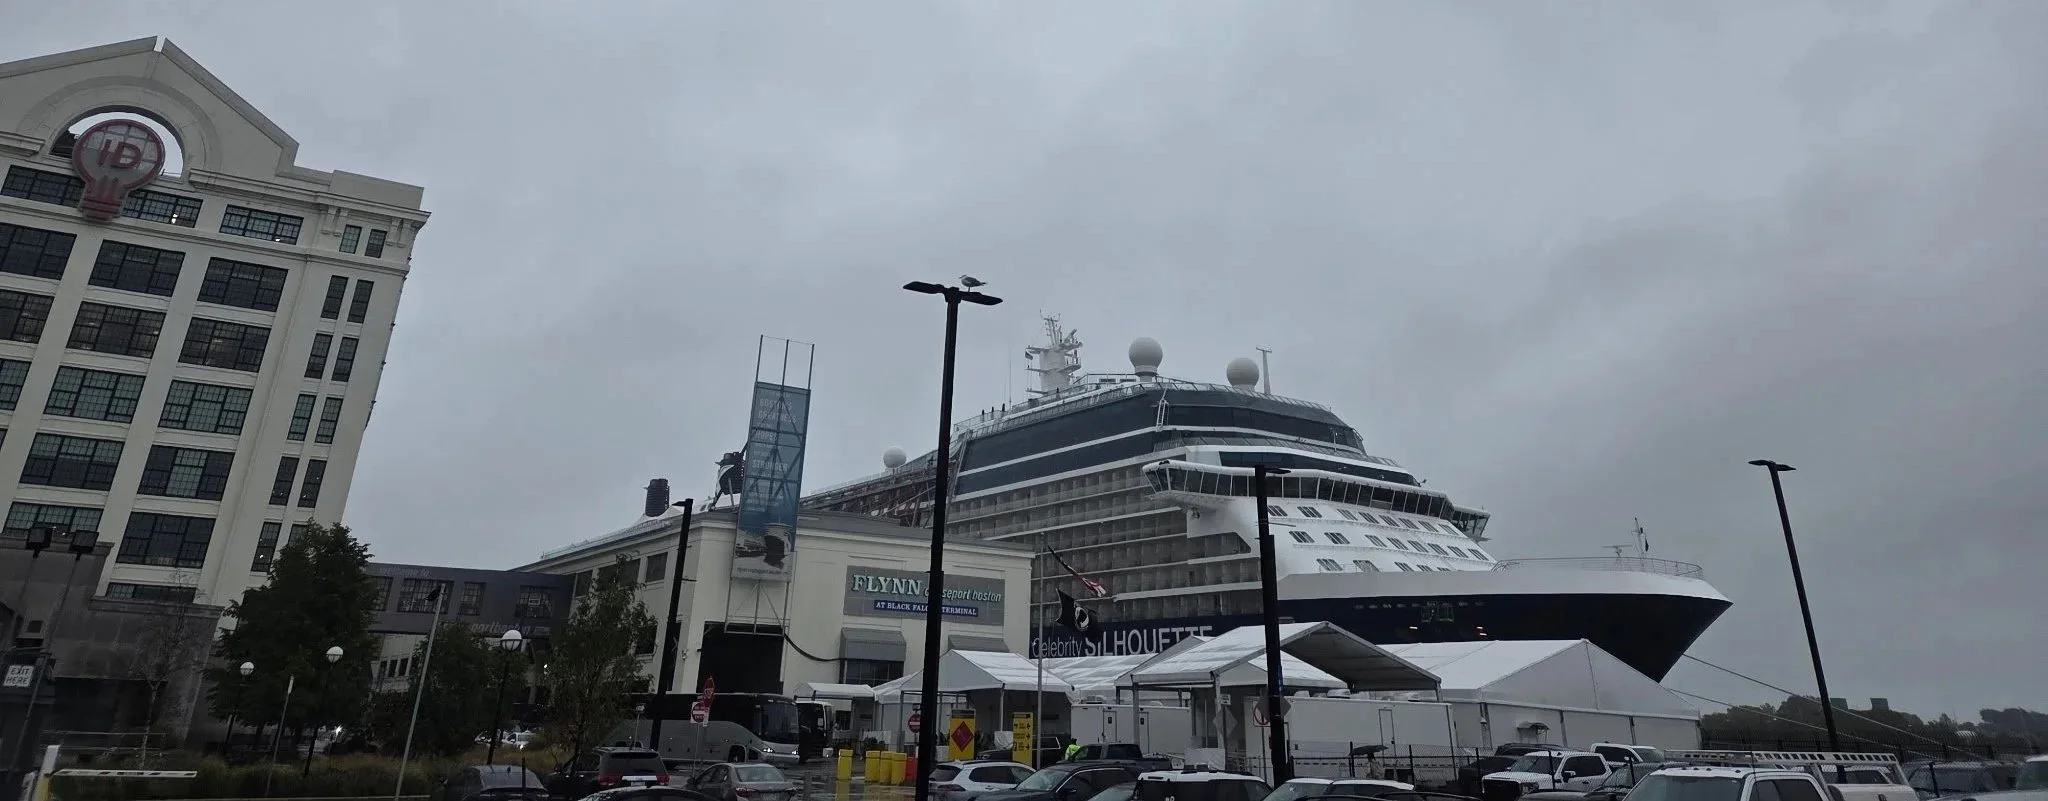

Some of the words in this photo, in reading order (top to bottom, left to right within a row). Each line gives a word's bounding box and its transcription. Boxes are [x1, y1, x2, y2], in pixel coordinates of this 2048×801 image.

[96, 138, 142, 169] ID
[852, 574, 921, 595] FLYNN
[924, 587, 970, 601] cseport
[876, 601, 886, 609] AT
[887, 602, 910, 611] BLACK
[941, 606, 977, 616] TERMINAL
[1032, 635, 1083, 658] Celebrity
[6, 676, 28, 685] HERE
[11, 667, 30, 675] EXIT
